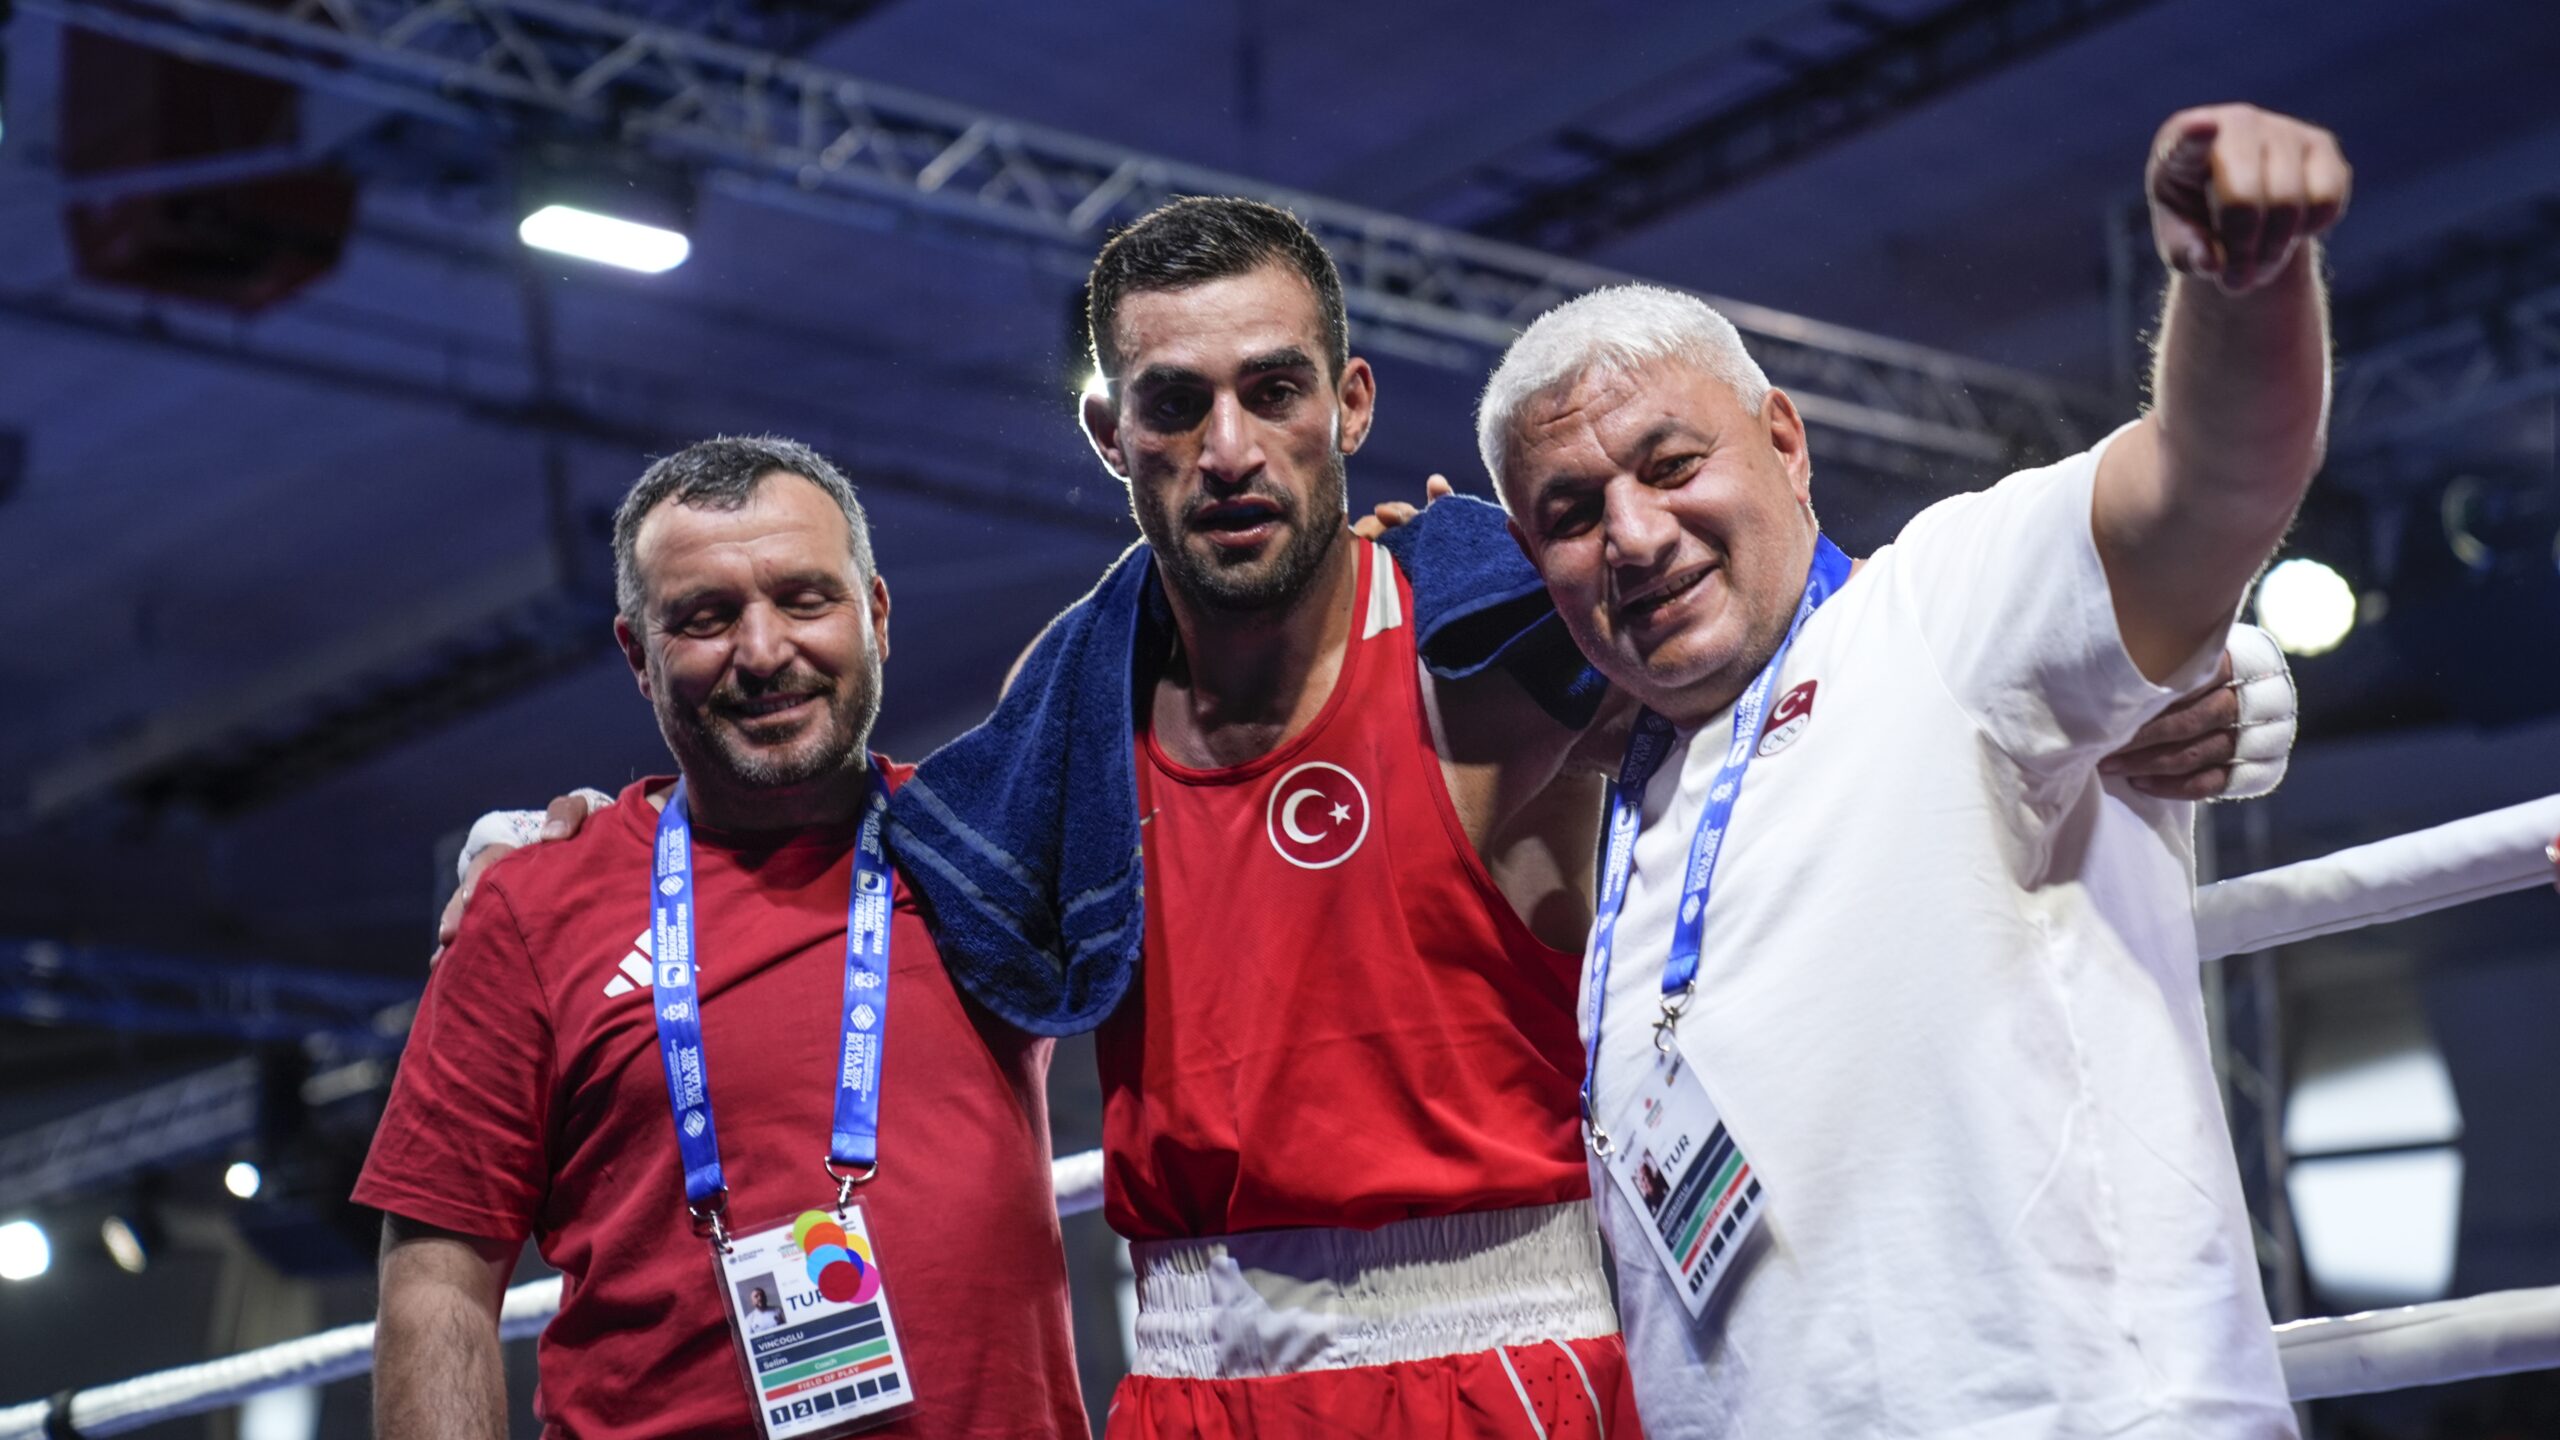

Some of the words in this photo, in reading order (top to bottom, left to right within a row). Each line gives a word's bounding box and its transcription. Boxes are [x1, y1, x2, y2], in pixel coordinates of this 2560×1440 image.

[853, 892, 866, 955] FEDERATION
[864, 895, 875, 931] BOXING
[872, 896, 886, 955] BULGARIAN
[657, 908, 667, 961] BULGARIAN
[667, 925, 678, 961] BOXING
[677, 903, 689, 961] FEDERATION
[678, 1047, 691, 1073] 2026
[842, 1031, 857, 1089] BULGARIA
[853, 1033, 865, 1065] SOFIA
[683, 1072, 694, 1107] SOFIA
[688, 1045, 704, 1105] BULGARIA
[851, 1066, 862, 1091] 2026
[1662, 1134, 1692, 1174] TUR
[758, 1331, 805, 1351] VINCOGLU
[763, 1356, 788, 1370] Selim
[798, 1377, 823, 1391] FIELD
[824, 1373, 835, 1383] OF
[837, 1367, 860, 1380] PLAY
[814, 1358, 838, 1371] Coach
[776, 1410, 785, 1422] 1
[799, 1403, 809, 1417] 2
